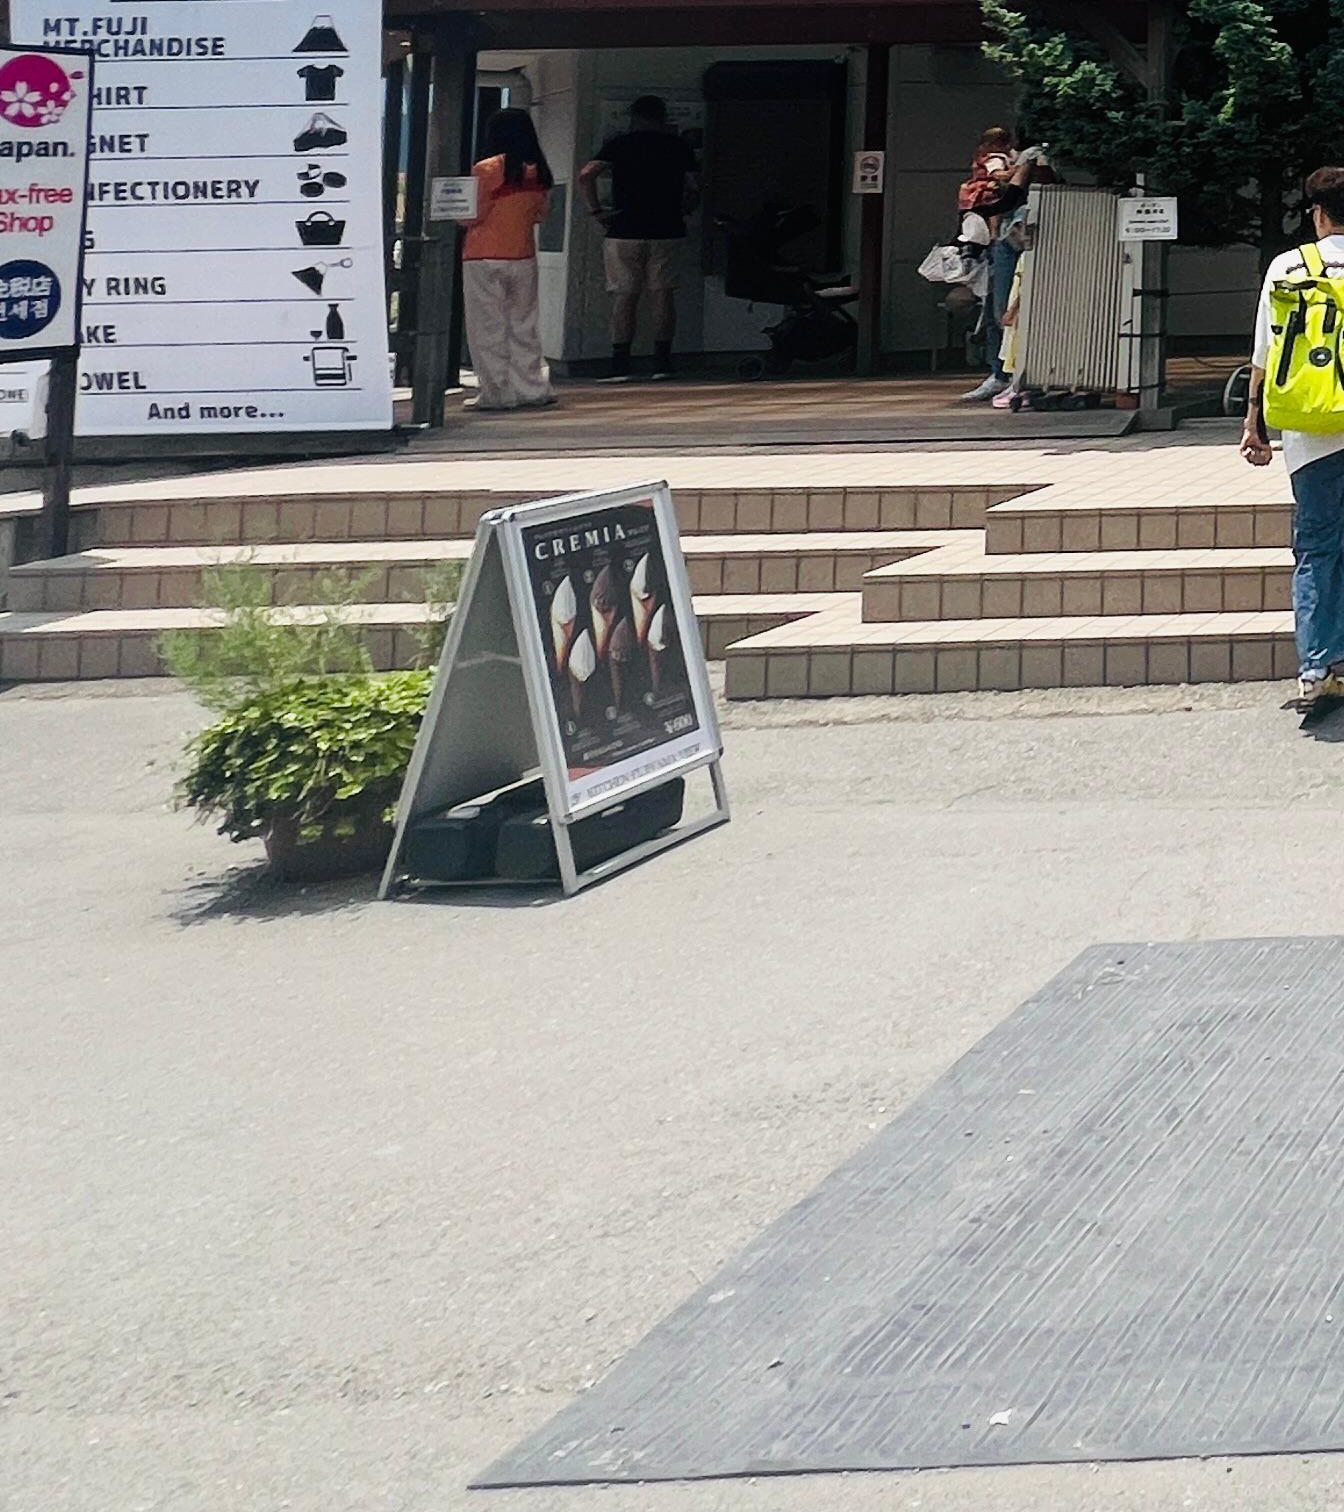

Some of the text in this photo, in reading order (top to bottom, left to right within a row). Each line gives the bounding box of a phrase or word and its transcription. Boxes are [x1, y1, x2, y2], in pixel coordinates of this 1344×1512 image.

[43, 16, 148, 36] MT.FUJI
[0, 211, 53, 237] Shop
[106, 276, 166, 296] RING
[81, 325, 117, 344] KE
[147, 402, 284, 420] And more...
[534, 523, 626, 561] CREMIA
